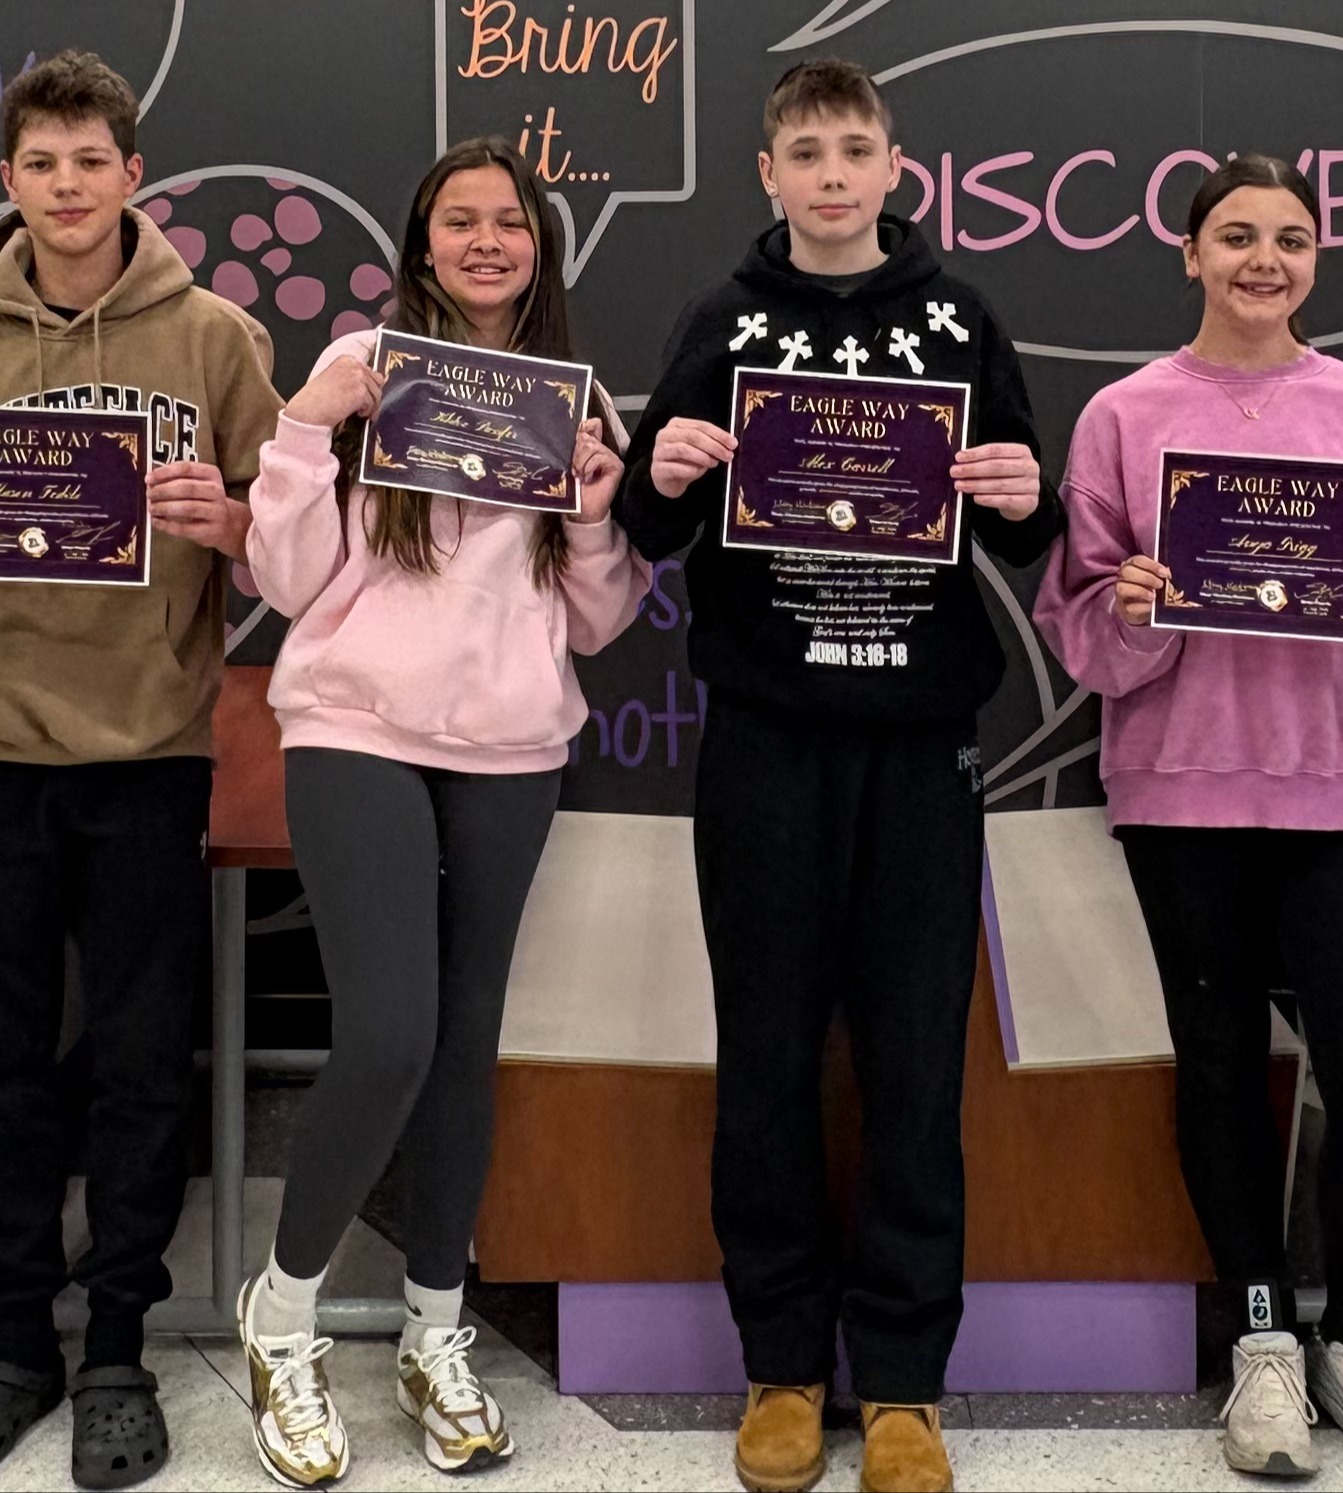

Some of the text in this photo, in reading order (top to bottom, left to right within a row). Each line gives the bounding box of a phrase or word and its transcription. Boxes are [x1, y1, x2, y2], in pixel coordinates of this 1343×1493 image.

[458, 0, 678, 104] Bring
[426, 360, 537, 393] EAGLE WAY
[444, 383, 514, 407] AWARD
[790, 395, 910, 420] EAGLE WAY
[47, 430, 94, 448] WAY
[811, 418, 886, 439] AWARD
[798, 453, 836, 469] Alex
[1217, 475, 1339, 499] EAGLE WAY
[1238, 497, 1316, 517] AWARD
[805, 642, 847, 665] JOHN
